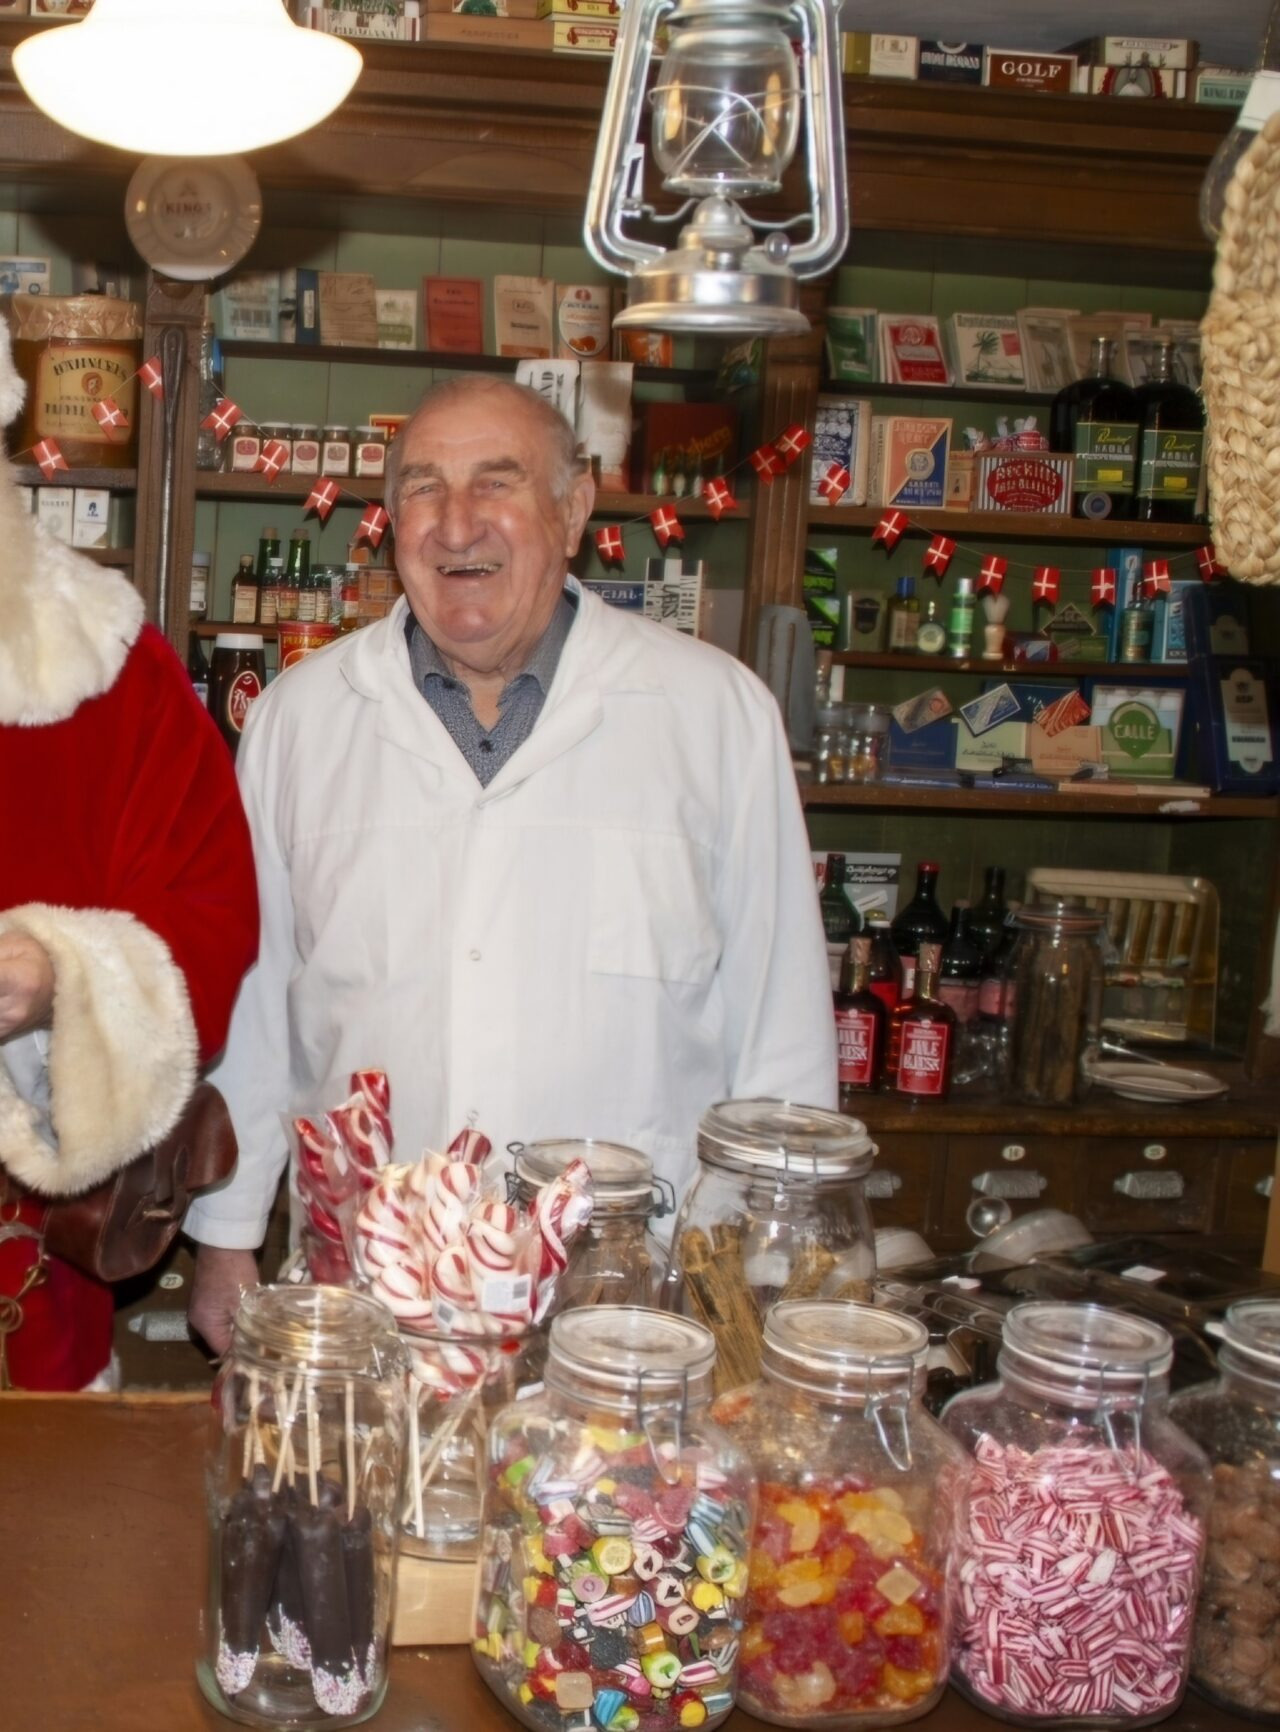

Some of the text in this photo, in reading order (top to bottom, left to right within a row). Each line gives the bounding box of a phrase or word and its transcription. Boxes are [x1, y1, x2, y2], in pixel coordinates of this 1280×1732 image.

[1001, 60, 1062, 78] GOLF
[1113, 724, 1157, 741] CALLE
[908, 1039, 938, 1057] JULE
